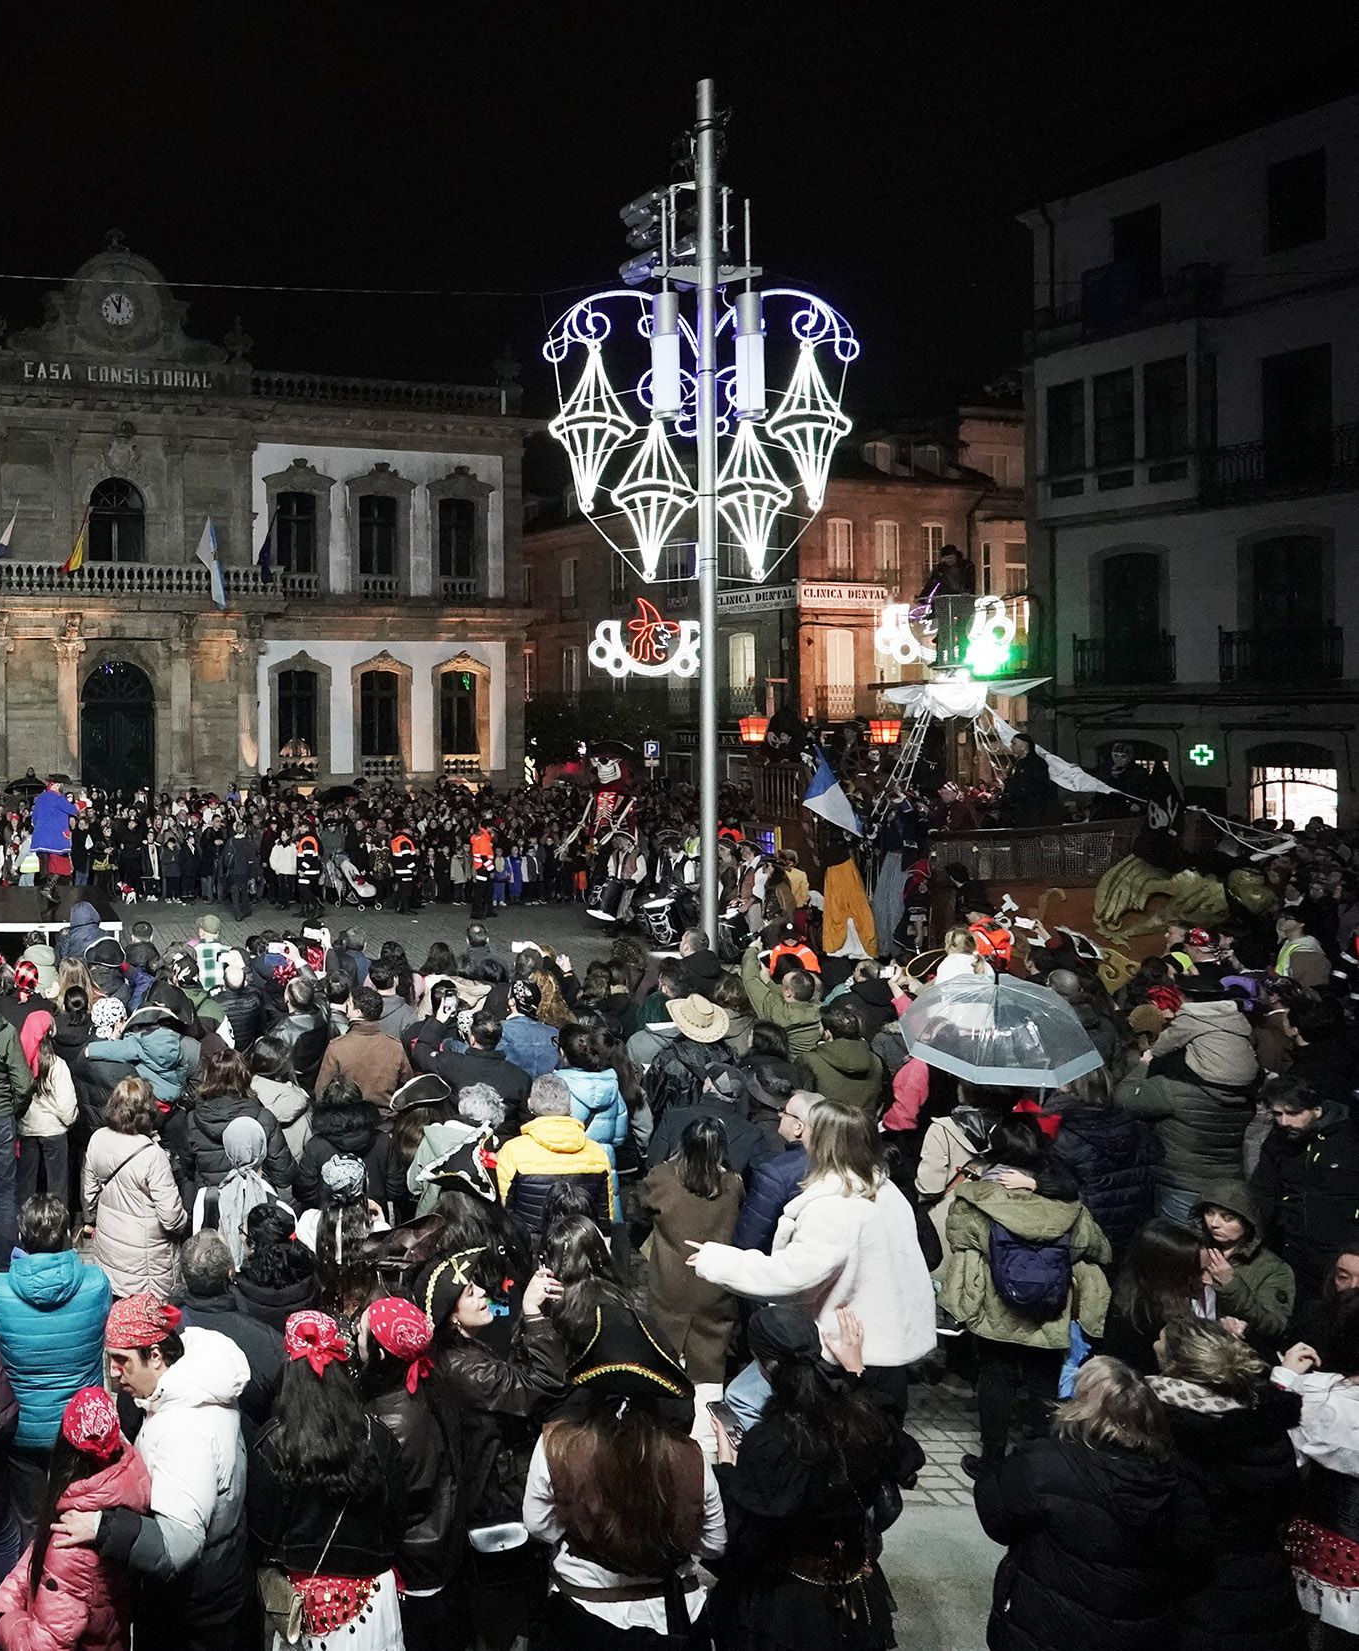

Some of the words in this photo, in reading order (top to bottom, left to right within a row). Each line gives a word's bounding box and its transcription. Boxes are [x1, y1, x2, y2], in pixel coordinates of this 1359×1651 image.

[23, 361, 72, 381] CASA
[87, 365, 212, 389] CONSISTORIAL
[755, 589, 795, 602] DENTAL
[803, 588, 843, 599] CLINICA
[648, 743, 657, 757] P
